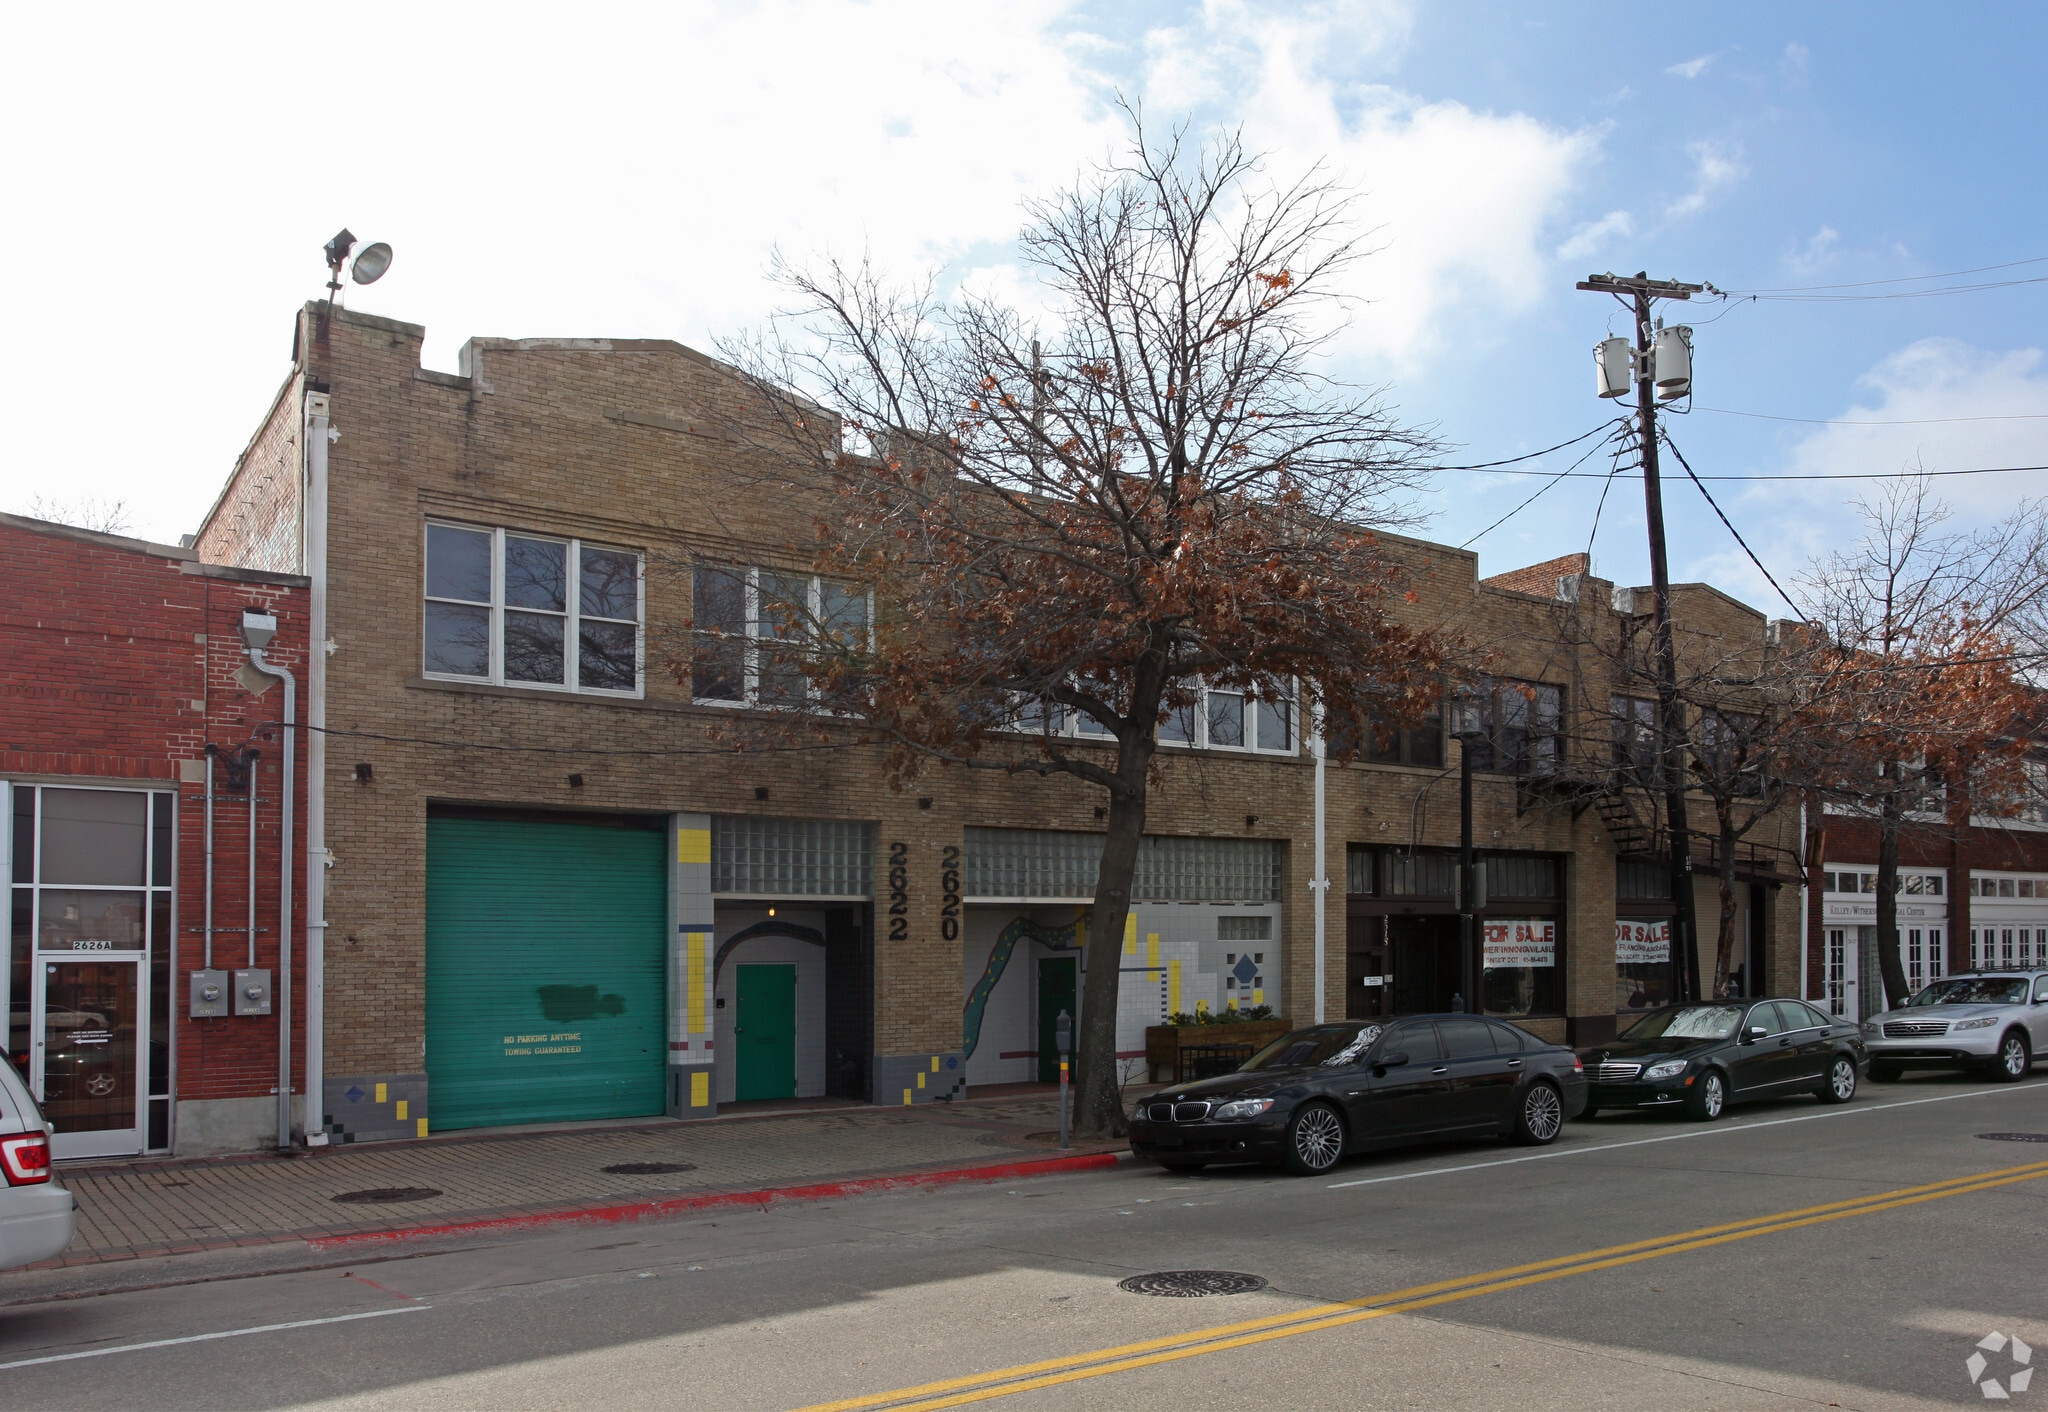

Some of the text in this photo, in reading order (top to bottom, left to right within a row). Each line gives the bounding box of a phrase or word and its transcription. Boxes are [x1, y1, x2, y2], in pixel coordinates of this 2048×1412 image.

[889, 842, 908, 941] 2622
[942, 846, 960, 941] 2620
[1484, 925, 1553, 942] FOR SALE
[1616, 925, 1670, 943] OR SALE
[74, 941, 111, 950] 2626A
[504, 1033, 581, 1044] NO PARKING ANYTIME
[504, 1046, 581, 1056] TOWING GUARANTEED
